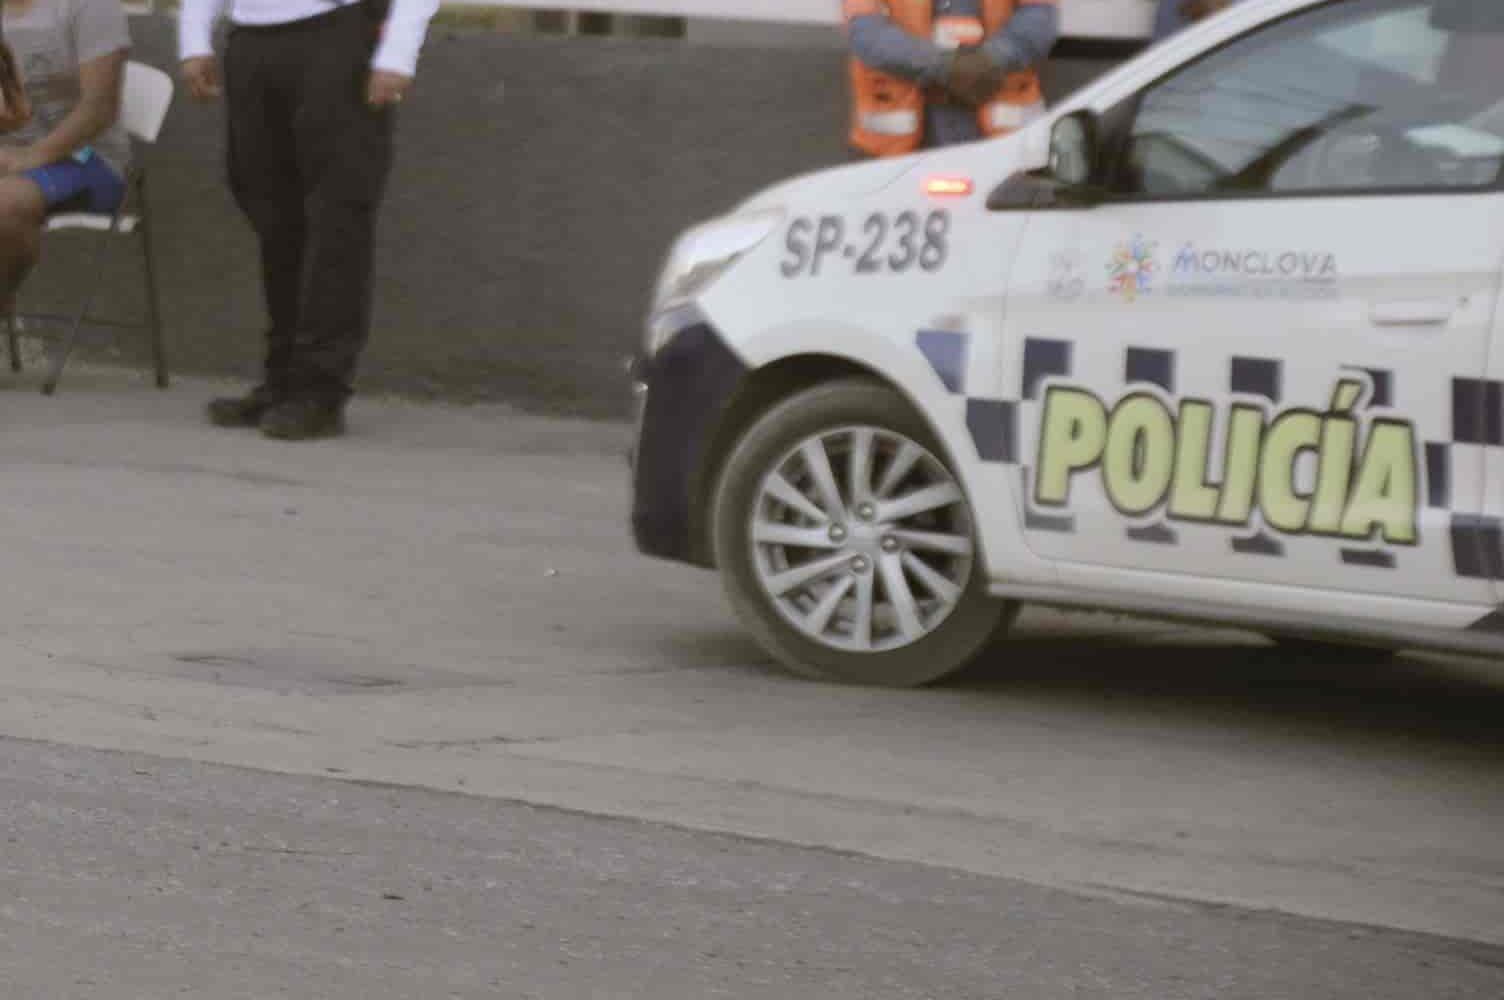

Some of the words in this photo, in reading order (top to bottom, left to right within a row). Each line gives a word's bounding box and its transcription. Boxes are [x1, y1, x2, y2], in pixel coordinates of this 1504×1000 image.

[780, 208, 950, 278] SP-238
[1174, 247, 1337, 276] MONCLOVA
[1034, 377, 1420, 547] POLICÍA
